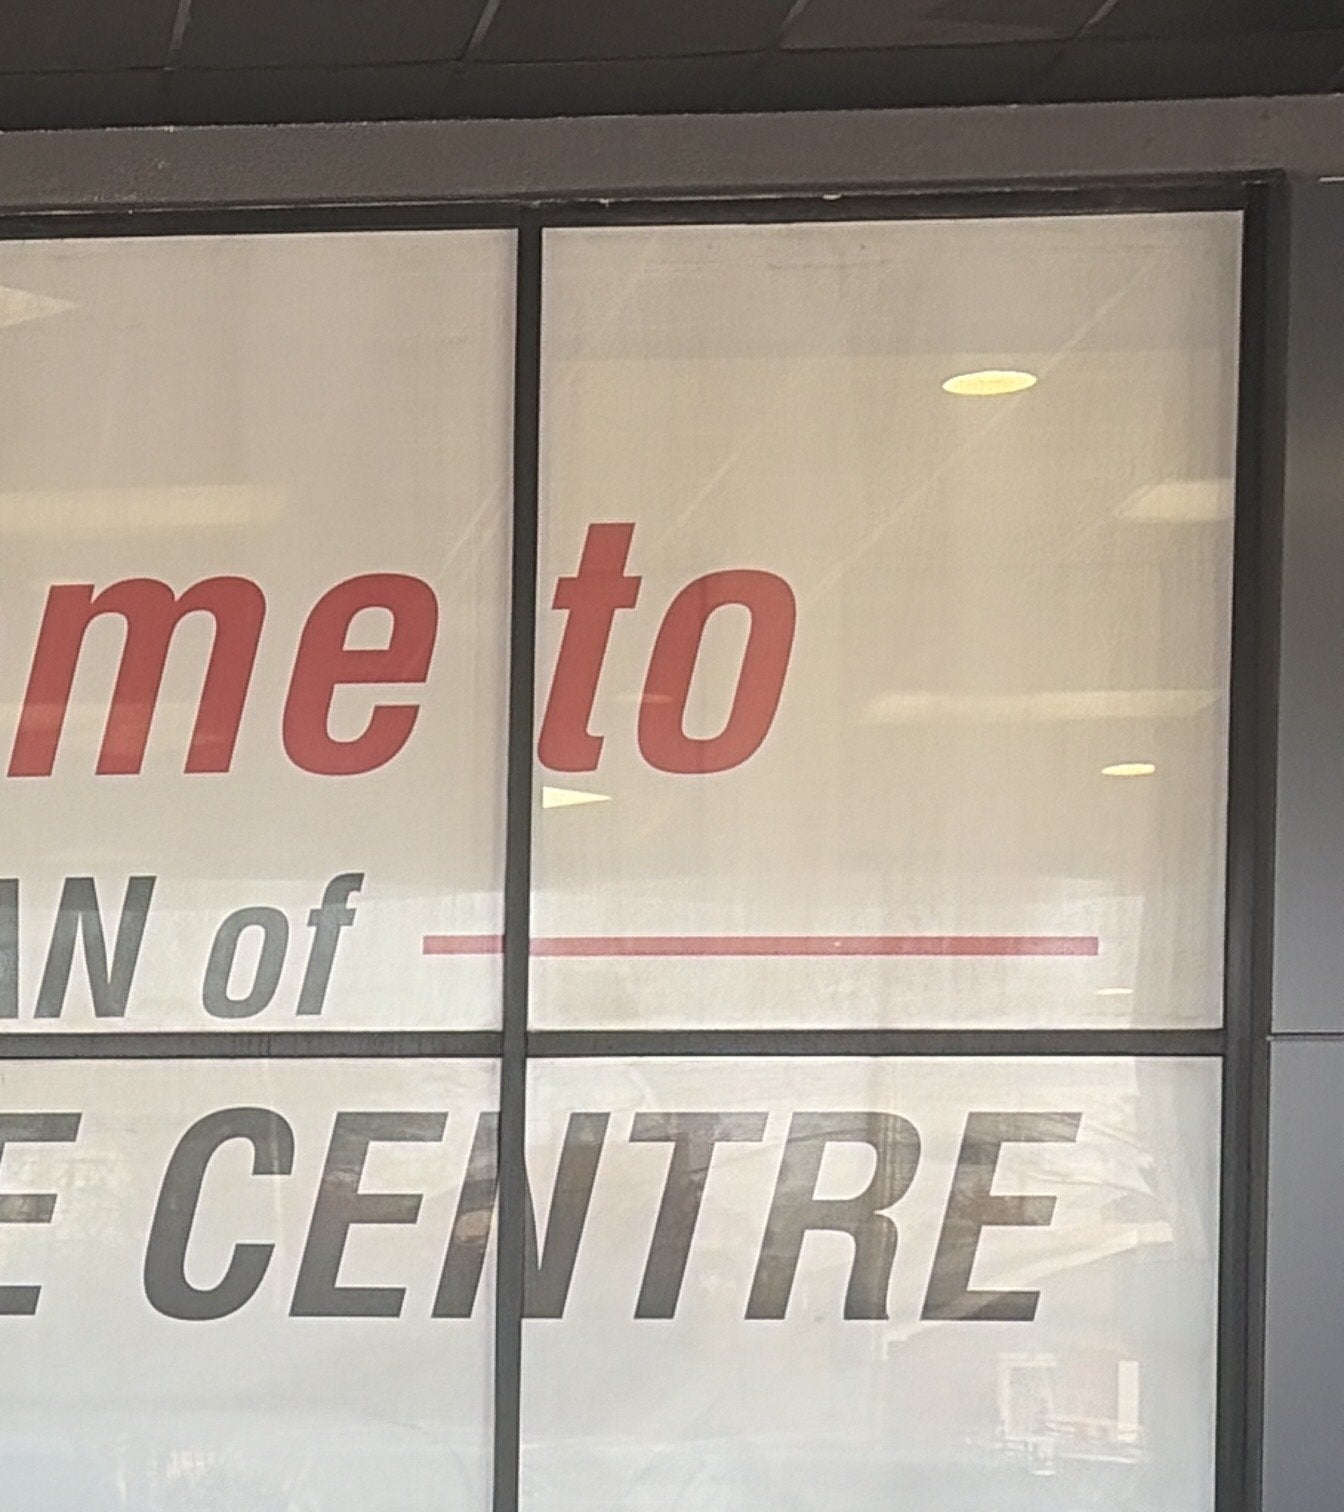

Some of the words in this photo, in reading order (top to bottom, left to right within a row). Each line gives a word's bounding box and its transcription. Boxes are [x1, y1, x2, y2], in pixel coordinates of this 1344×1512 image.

[536, 522, 797, 776] to
[201, 872, 365, 1020] of
[143, 1106, 1083, 1322] CENTRE
